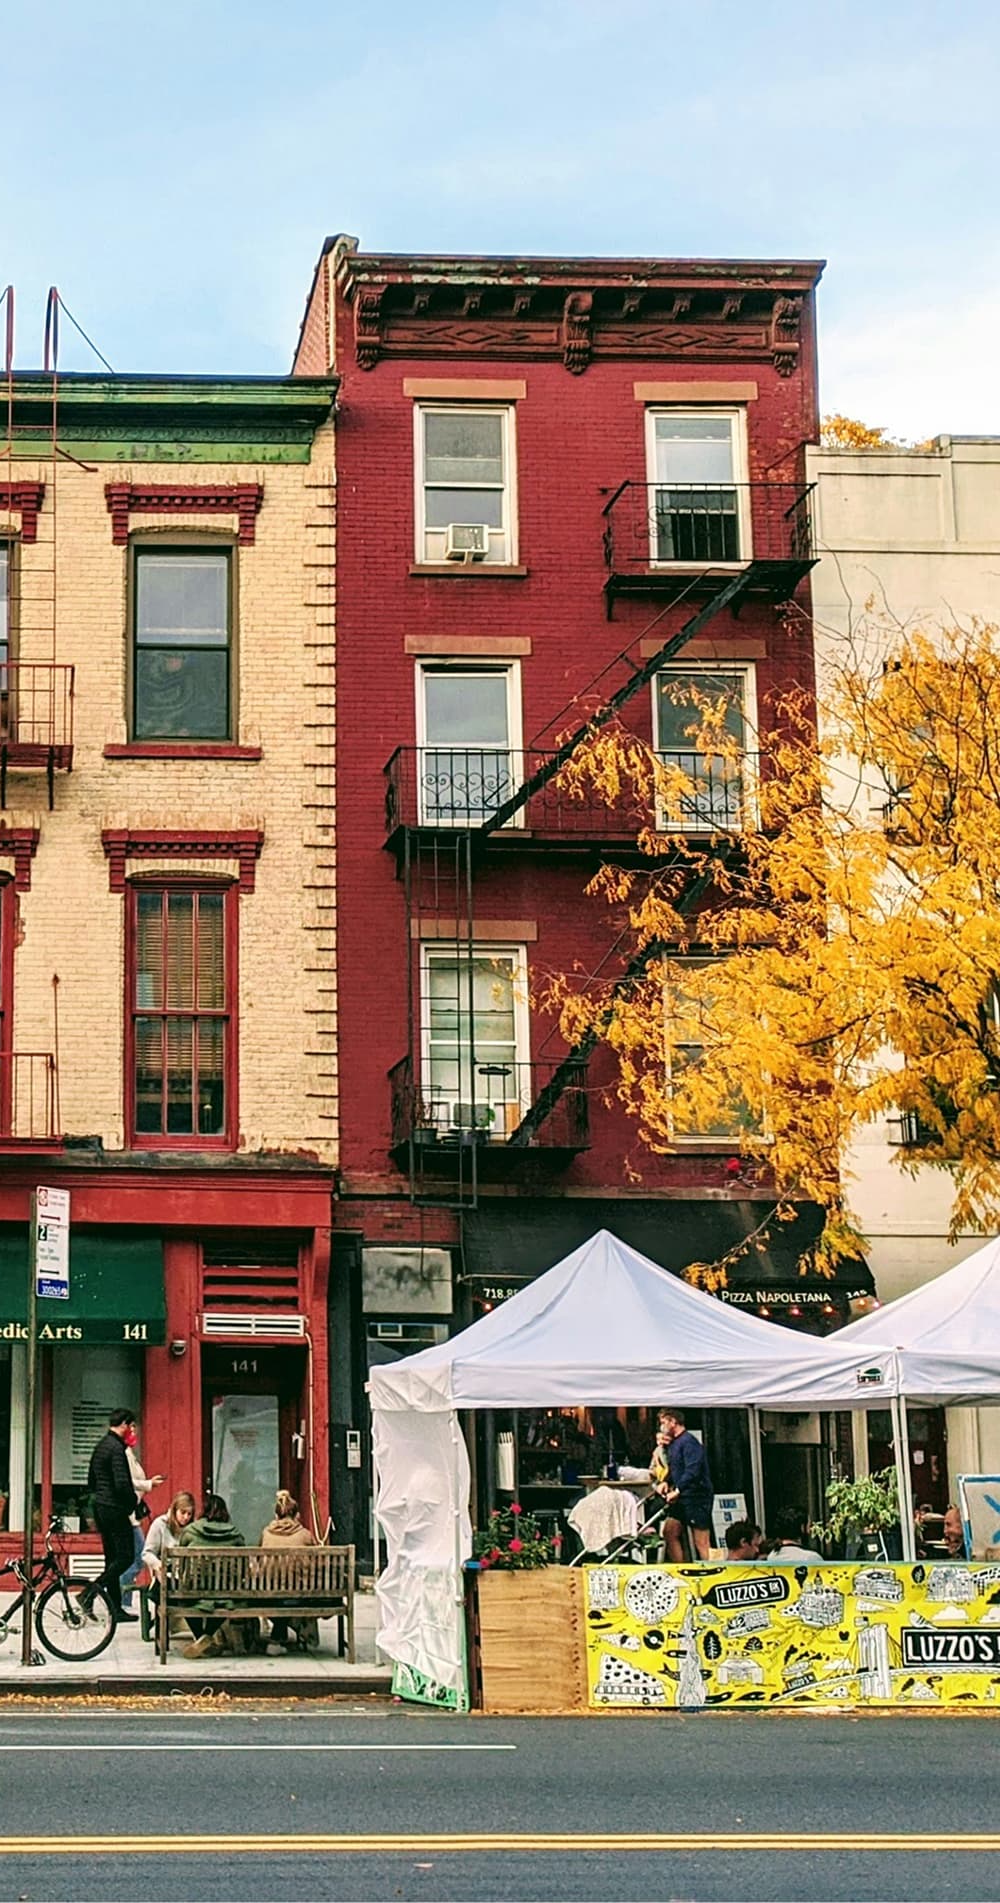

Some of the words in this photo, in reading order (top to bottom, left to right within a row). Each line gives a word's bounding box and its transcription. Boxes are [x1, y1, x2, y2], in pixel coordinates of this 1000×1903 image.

[722, 1290, 753, 1303] PIZZA
[756, 1290, 832, 1303] NAPOLETANA
[39, 1323, 82, 1339] Arts
[122, 1324, 147, 1340] 141
[231, 1359, 258, 1373] 141
[719, 1583, 768, 1604] LUZZO'S
[907, 1634, 994, 1662] LUZZO'S
